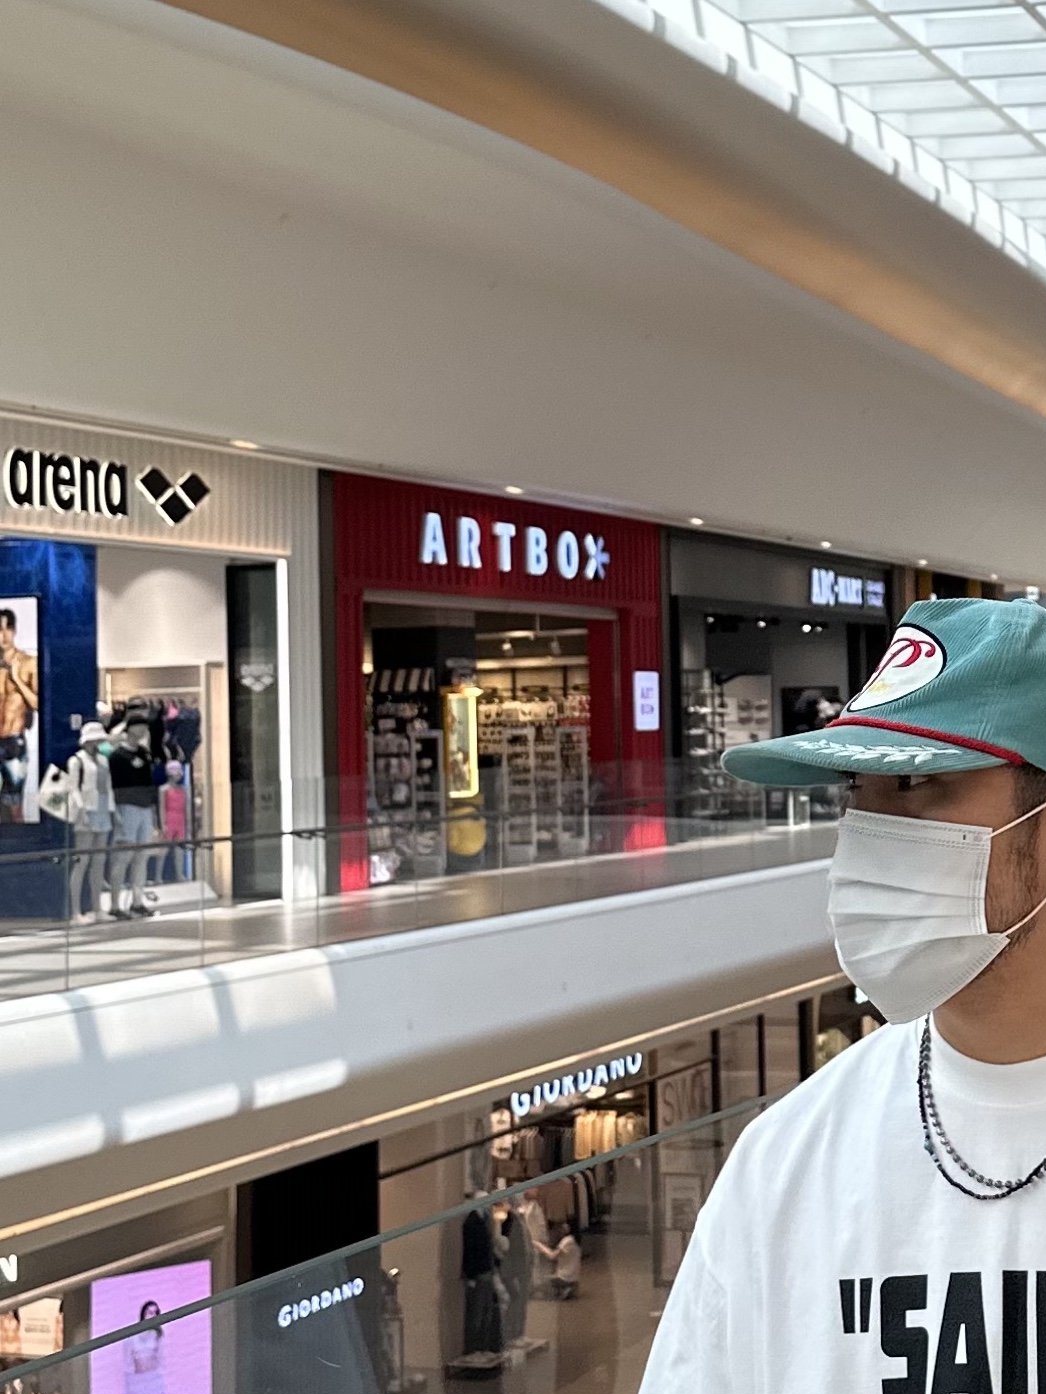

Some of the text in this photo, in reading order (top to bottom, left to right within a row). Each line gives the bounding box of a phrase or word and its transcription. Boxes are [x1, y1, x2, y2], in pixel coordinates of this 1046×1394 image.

[4, 447, 128, 519] arena
[421, 511, 610, 581] ARTBOX
[510, 1052, 643, 1117] GIORDANO
[277, 1277, 364, 1328] GIORDANO
